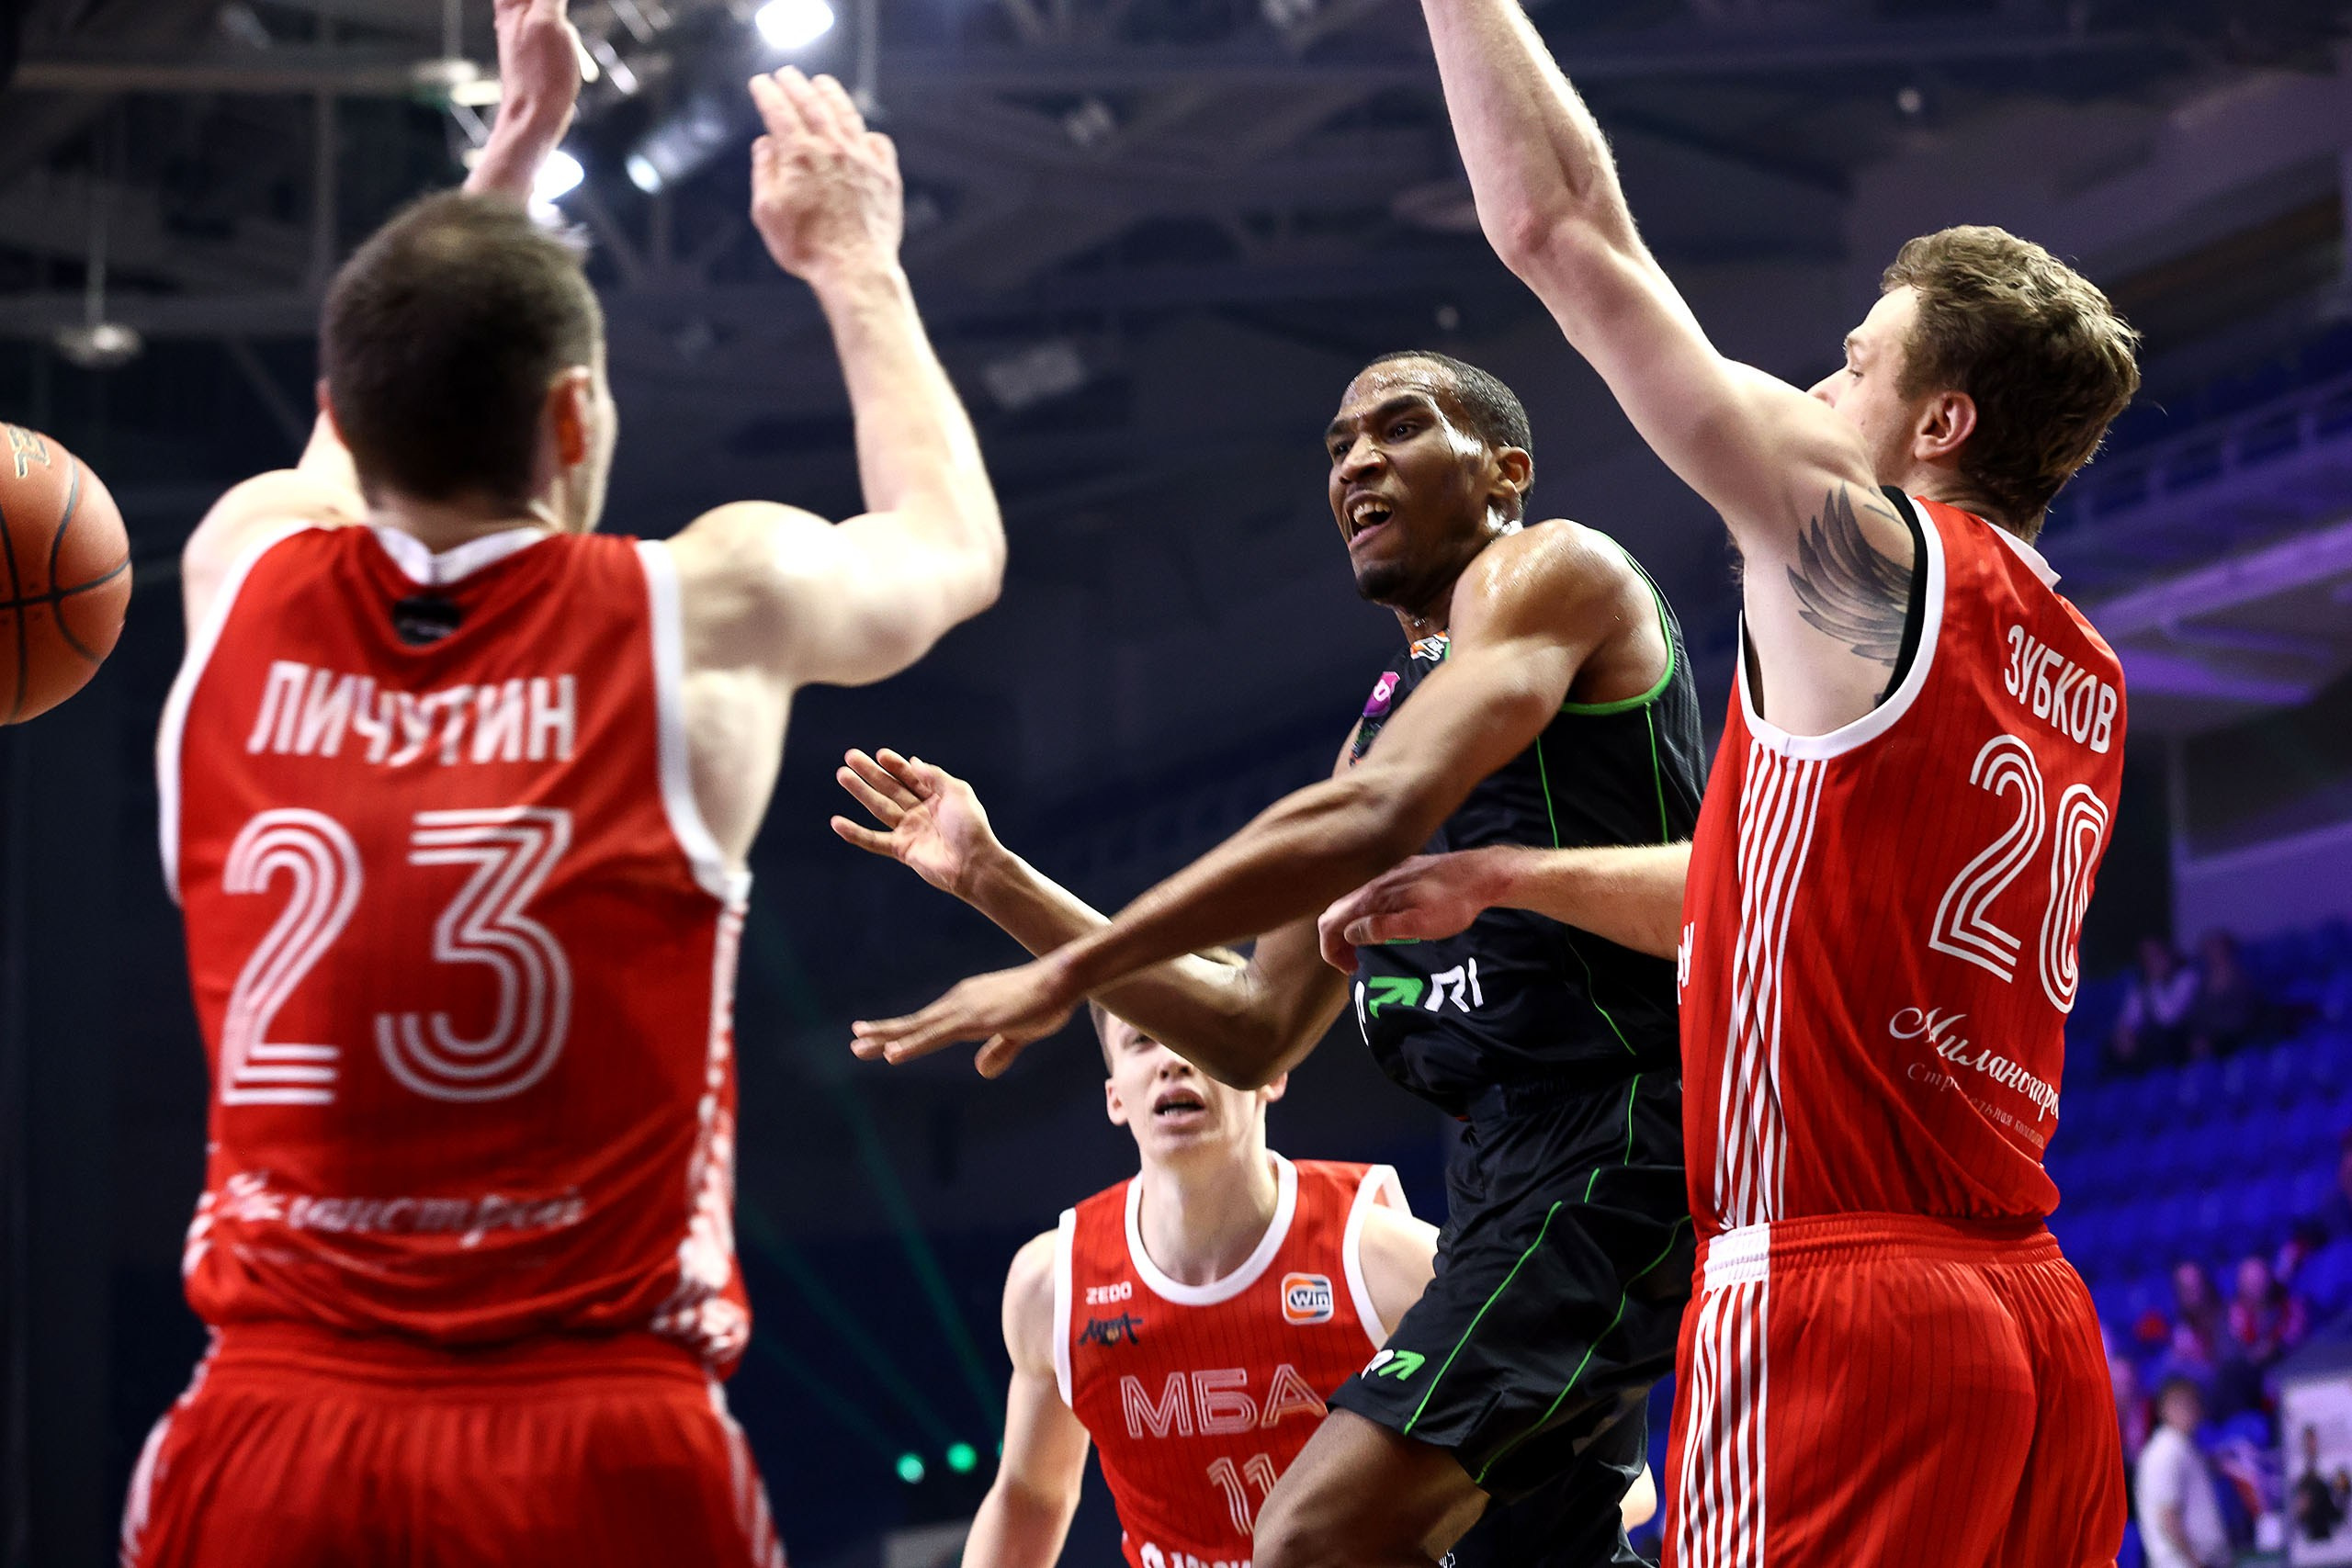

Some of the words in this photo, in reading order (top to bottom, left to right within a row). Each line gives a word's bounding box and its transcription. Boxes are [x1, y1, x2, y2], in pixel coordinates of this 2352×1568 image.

[2005, 625, 2118, 754] ЗУБКОВ
[1928, 734, 2109, 1014] 20
[220, 808, 571, 1105] 23
[1889, 1007, 2060, 1122] Миланстро
[1120, 1363, 1329, 1439] МБА
[1205, 1453, 1278, 1536] 11
